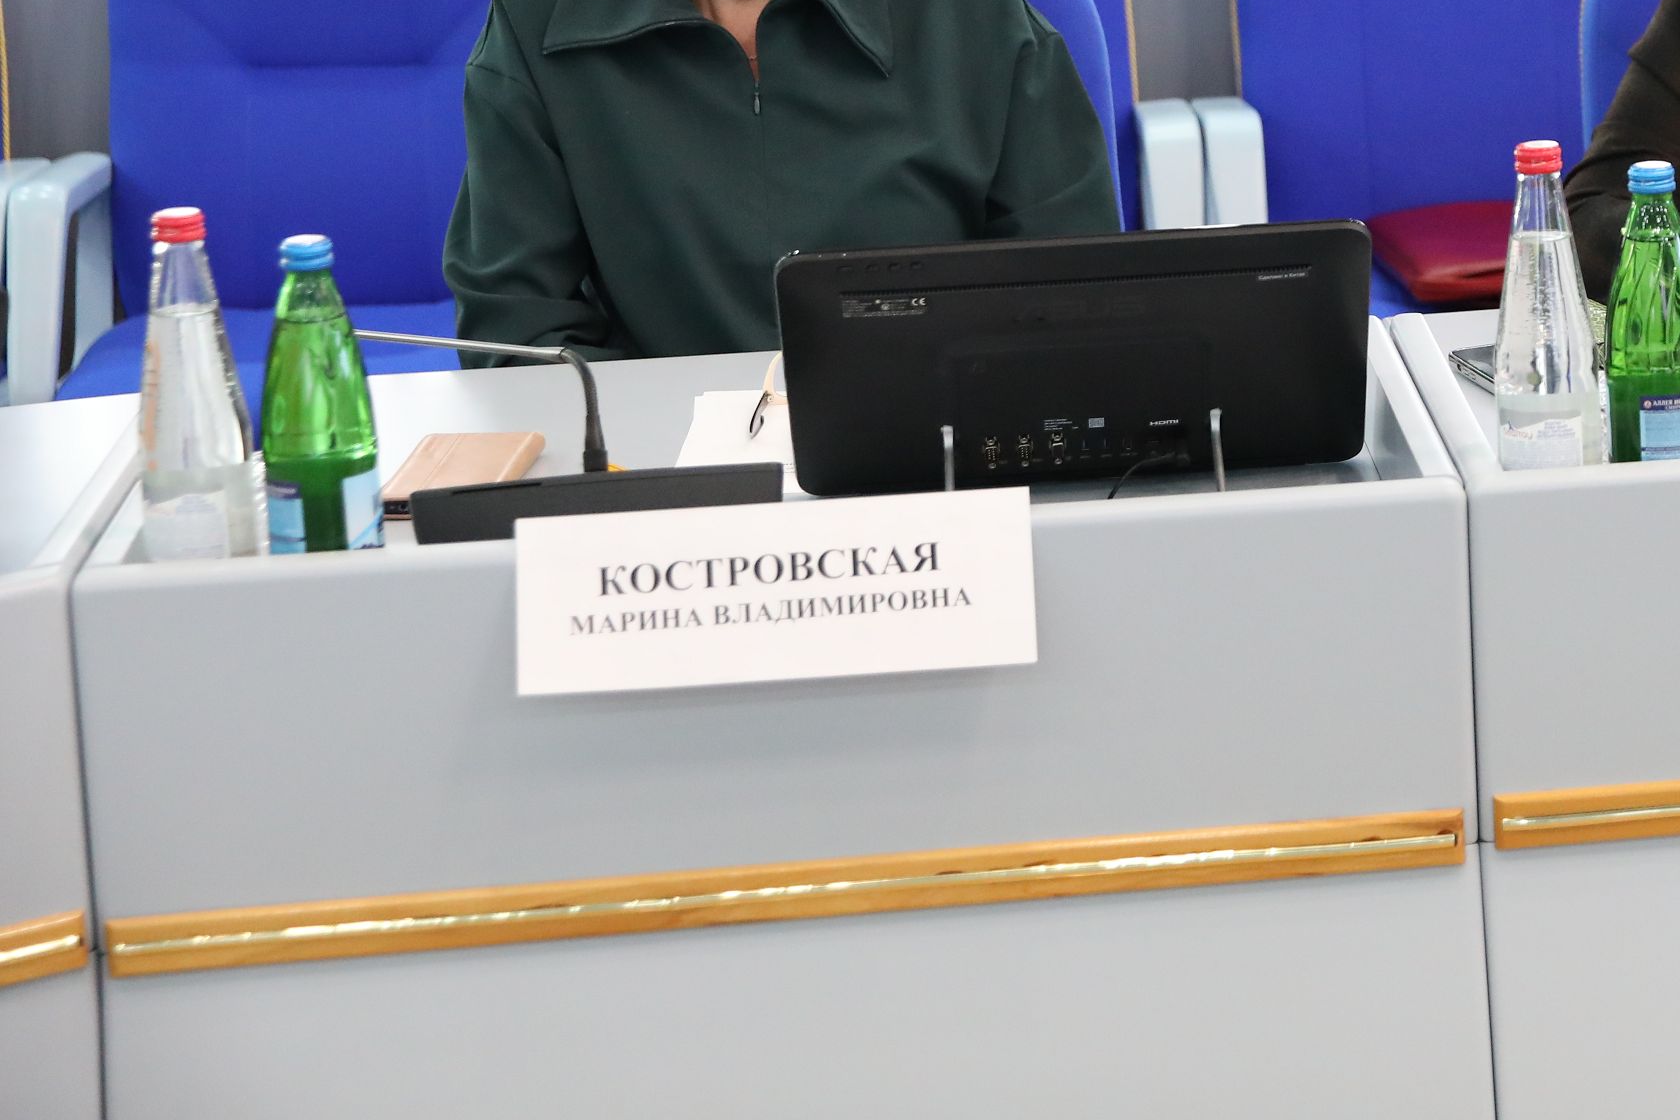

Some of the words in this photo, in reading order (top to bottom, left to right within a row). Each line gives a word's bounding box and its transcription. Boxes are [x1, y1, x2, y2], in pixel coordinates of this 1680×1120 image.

[599, 541, 940, 597] КОСТРОВСКАЯ
[569, 608, 704, 637] МАРИНА
[712, 586, 973, 627] ВЛАДИМИРОВНА
